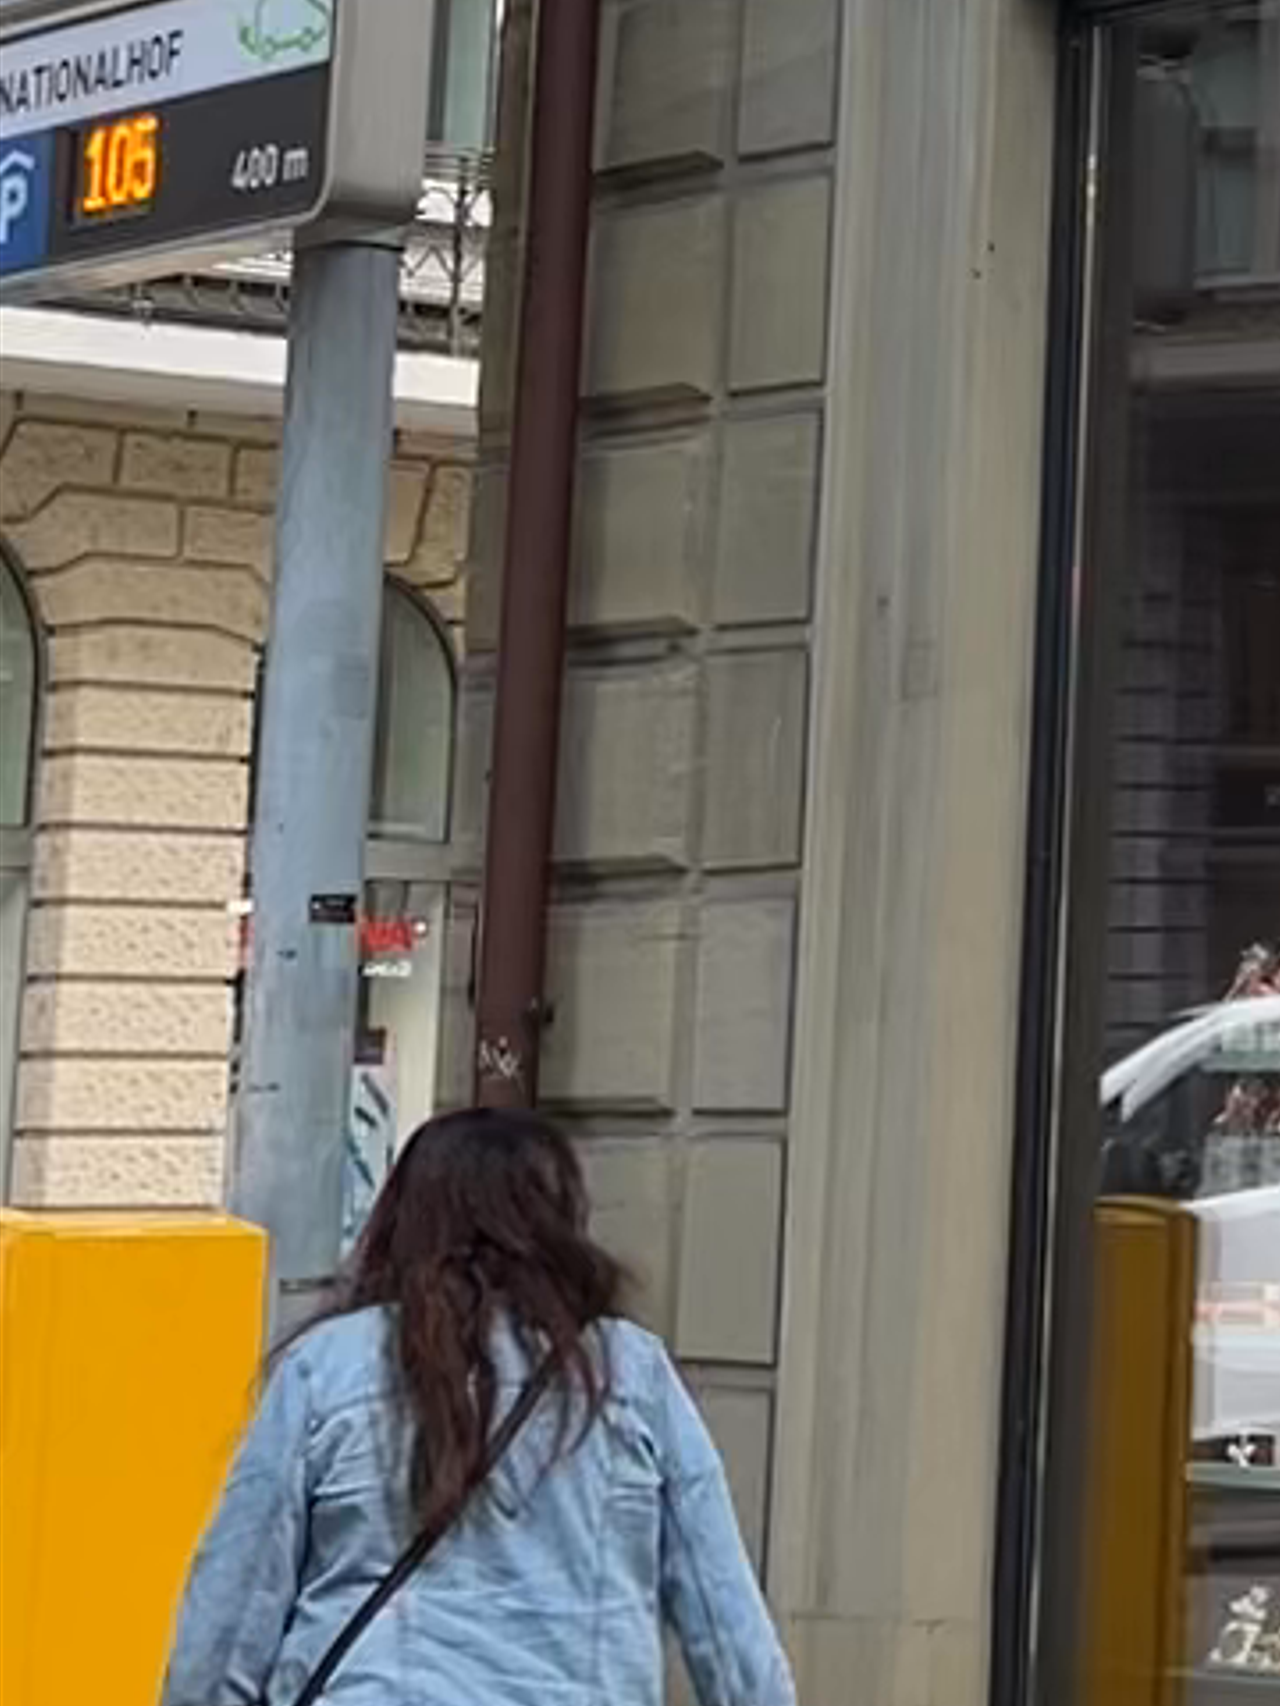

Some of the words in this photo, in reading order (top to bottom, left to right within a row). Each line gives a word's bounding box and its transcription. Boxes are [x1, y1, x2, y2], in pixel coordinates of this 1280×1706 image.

[0, 29, 184, 113] NATIONALHOF
[83, 113, 158, 211] 105
[231, 143, 279, 189] 400
[282, 147, 309, 182] m
